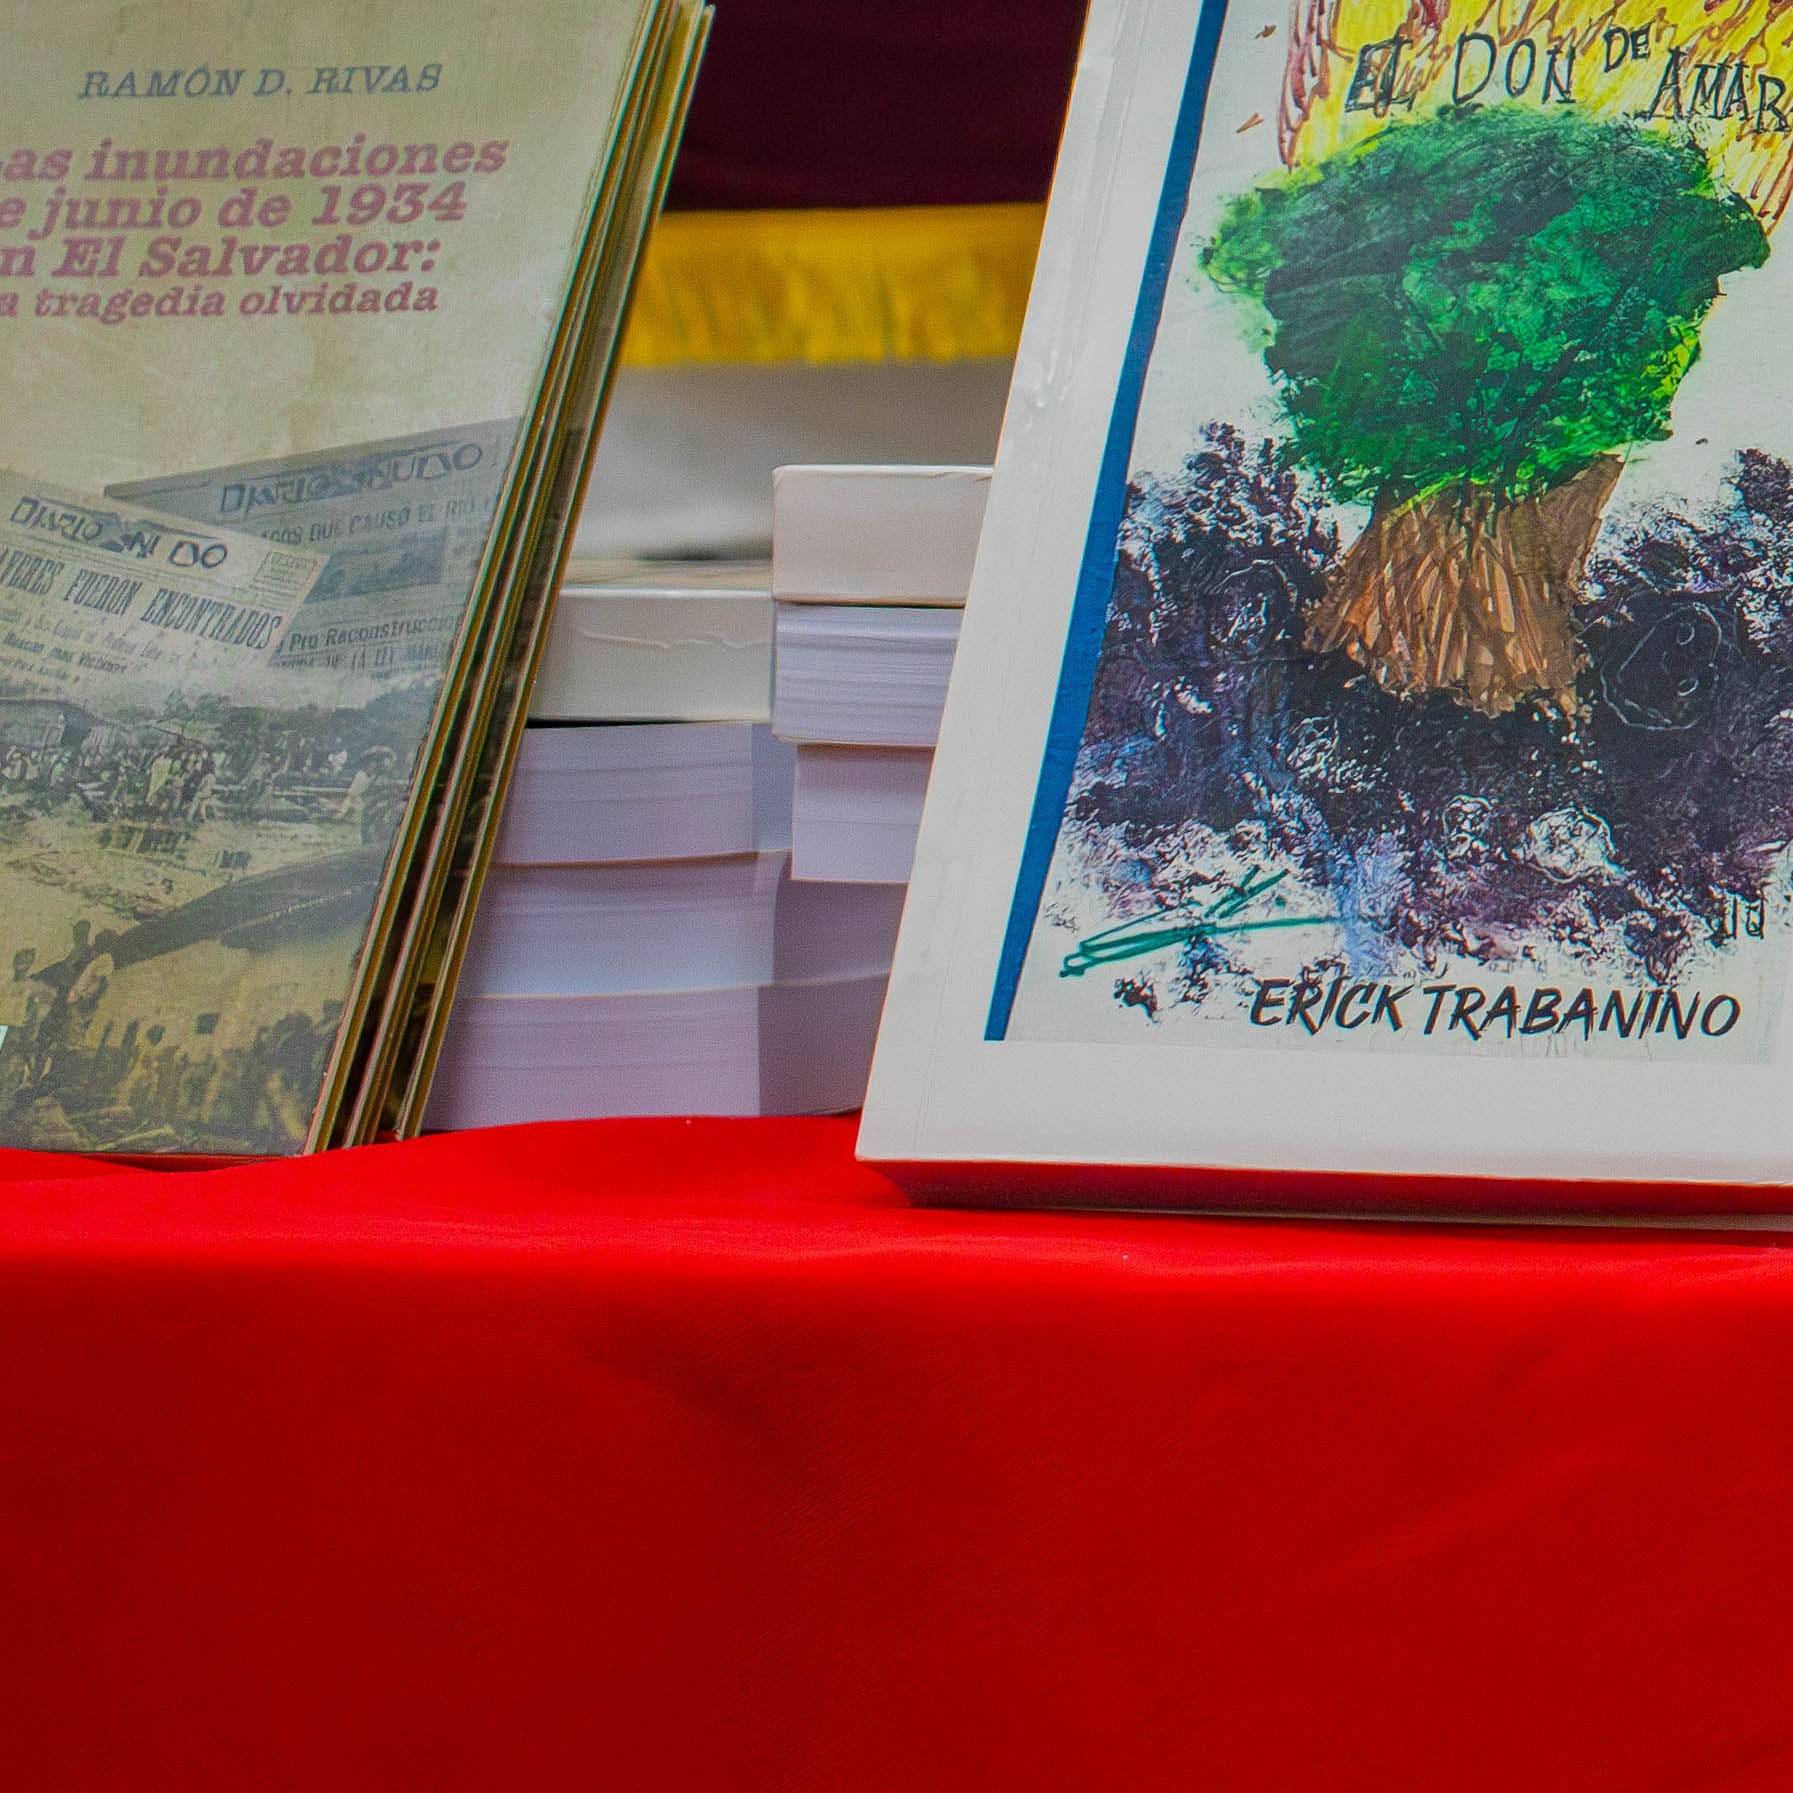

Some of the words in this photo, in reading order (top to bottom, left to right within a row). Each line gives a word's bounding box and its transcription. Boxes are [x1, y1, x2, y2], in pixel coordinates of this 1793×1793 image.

[79, 64, 246, 100] RAMÓN
[252, 67, 294, 98] D.
[306, 63, 443, 95] RIVAS
[1452, 31, 1577, 107] DON
[1603, 22, 1650, 71] DE
[1636, 44, 1791, 133] AMAR
[0, 148, 73, 182] as
[84, 133, 510, 182] inundaciones
[0, 195, 27, 229] e
[27, 185, 201, 241] junio
[217, 186, 291, 229] de
[310, 182, 468, 225] 1934
[0, 243, 35, 278] n
[52, 235, 126, 278] El
[137, 236, 442, 279] Salvador:
[34, 287, 225, 325] tragedia
[239, 280, 439, 317] olvidada
[1249, 976, 1415, 1037] ERICK
[1420, 982, 1742, 1042] TRABANINO
